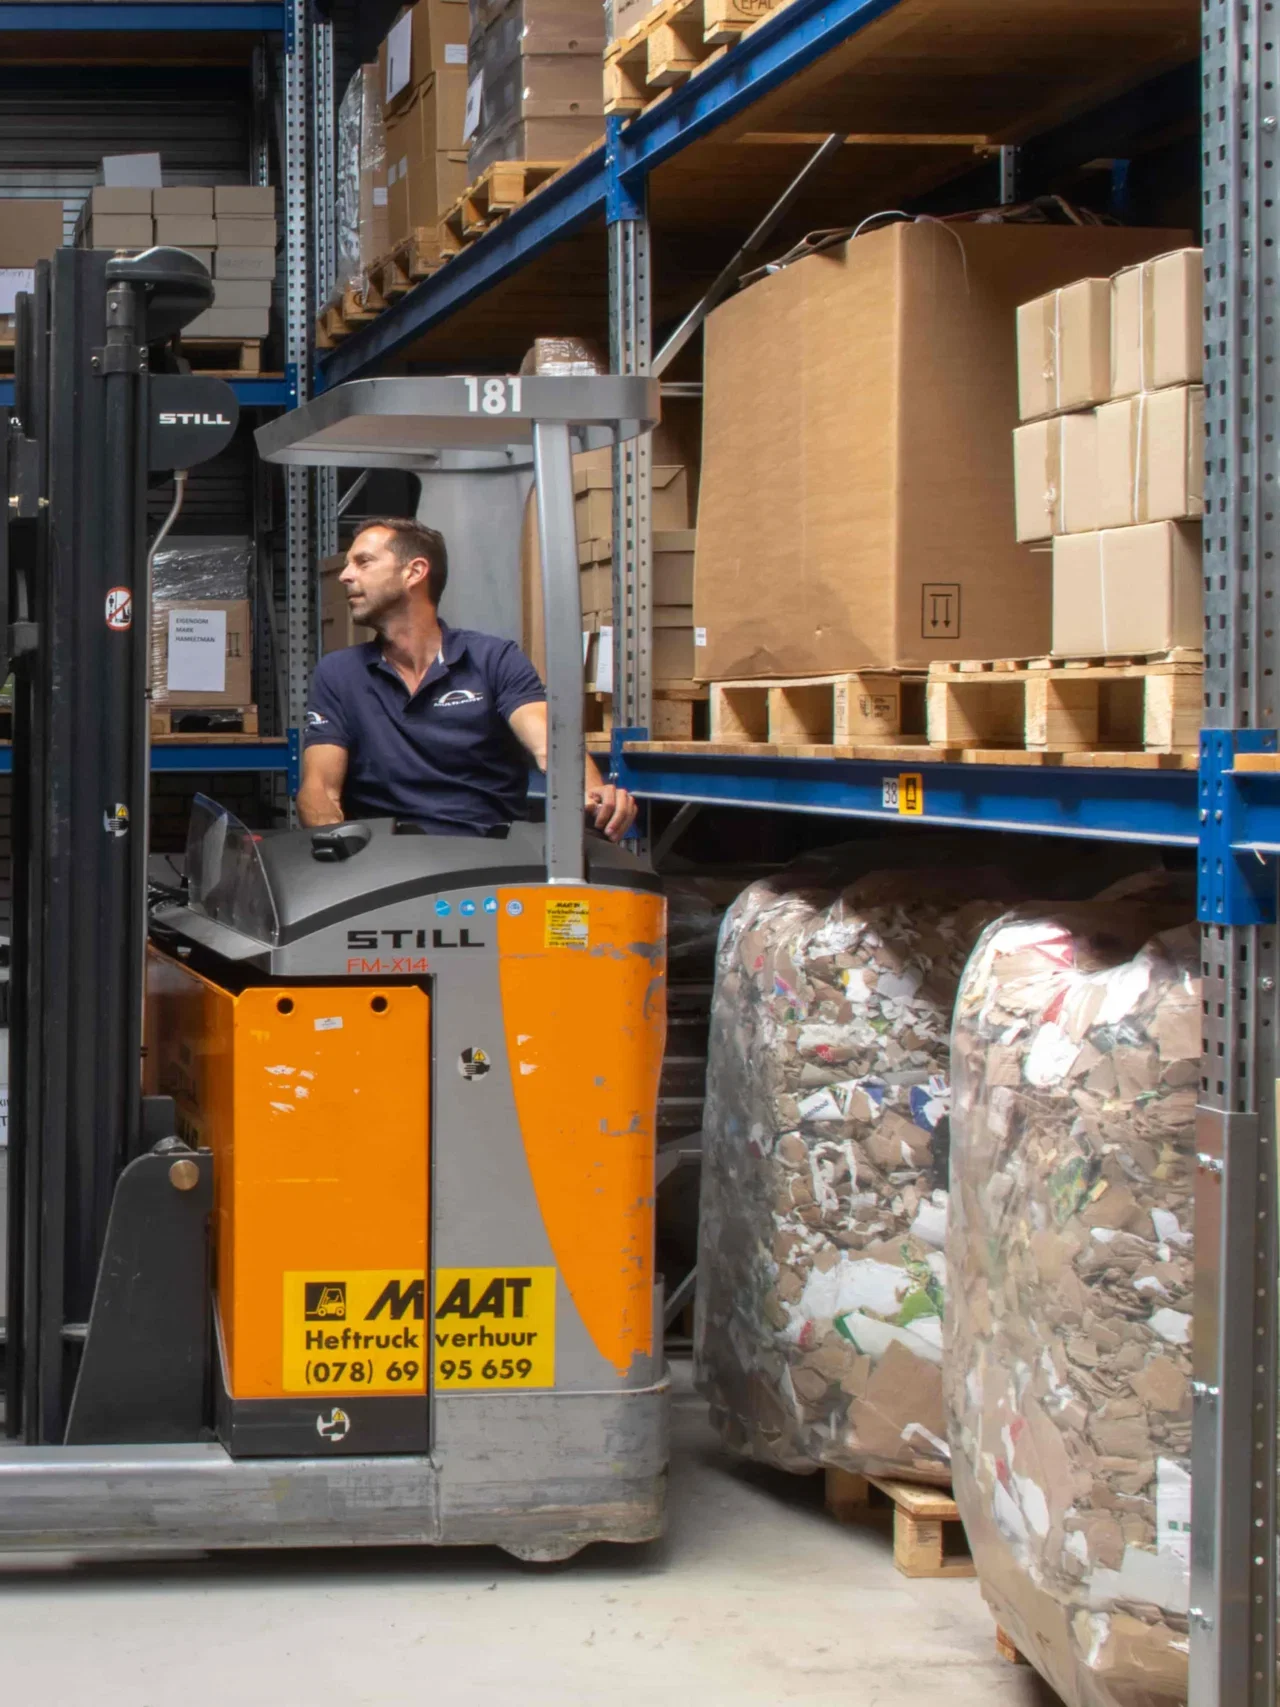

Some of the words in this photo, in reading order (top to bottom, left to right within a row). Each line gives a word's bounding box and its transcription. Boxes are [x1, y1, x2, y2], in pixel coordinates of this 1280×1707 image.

[464, 376, 522, 415] 181
[159, 412, 231, 426] STILL
[884, 781, 898, 805] 38
[347, 928, 485, 950] STILL
[347, 956, 429, 974] FM-X14
[364, 1277, 532, 1320] MAAT
[305, 1360, 374, 1384] (078)
[386, 1361, 419, 1381] 69
[481, 1358, 533, 1380] 659
